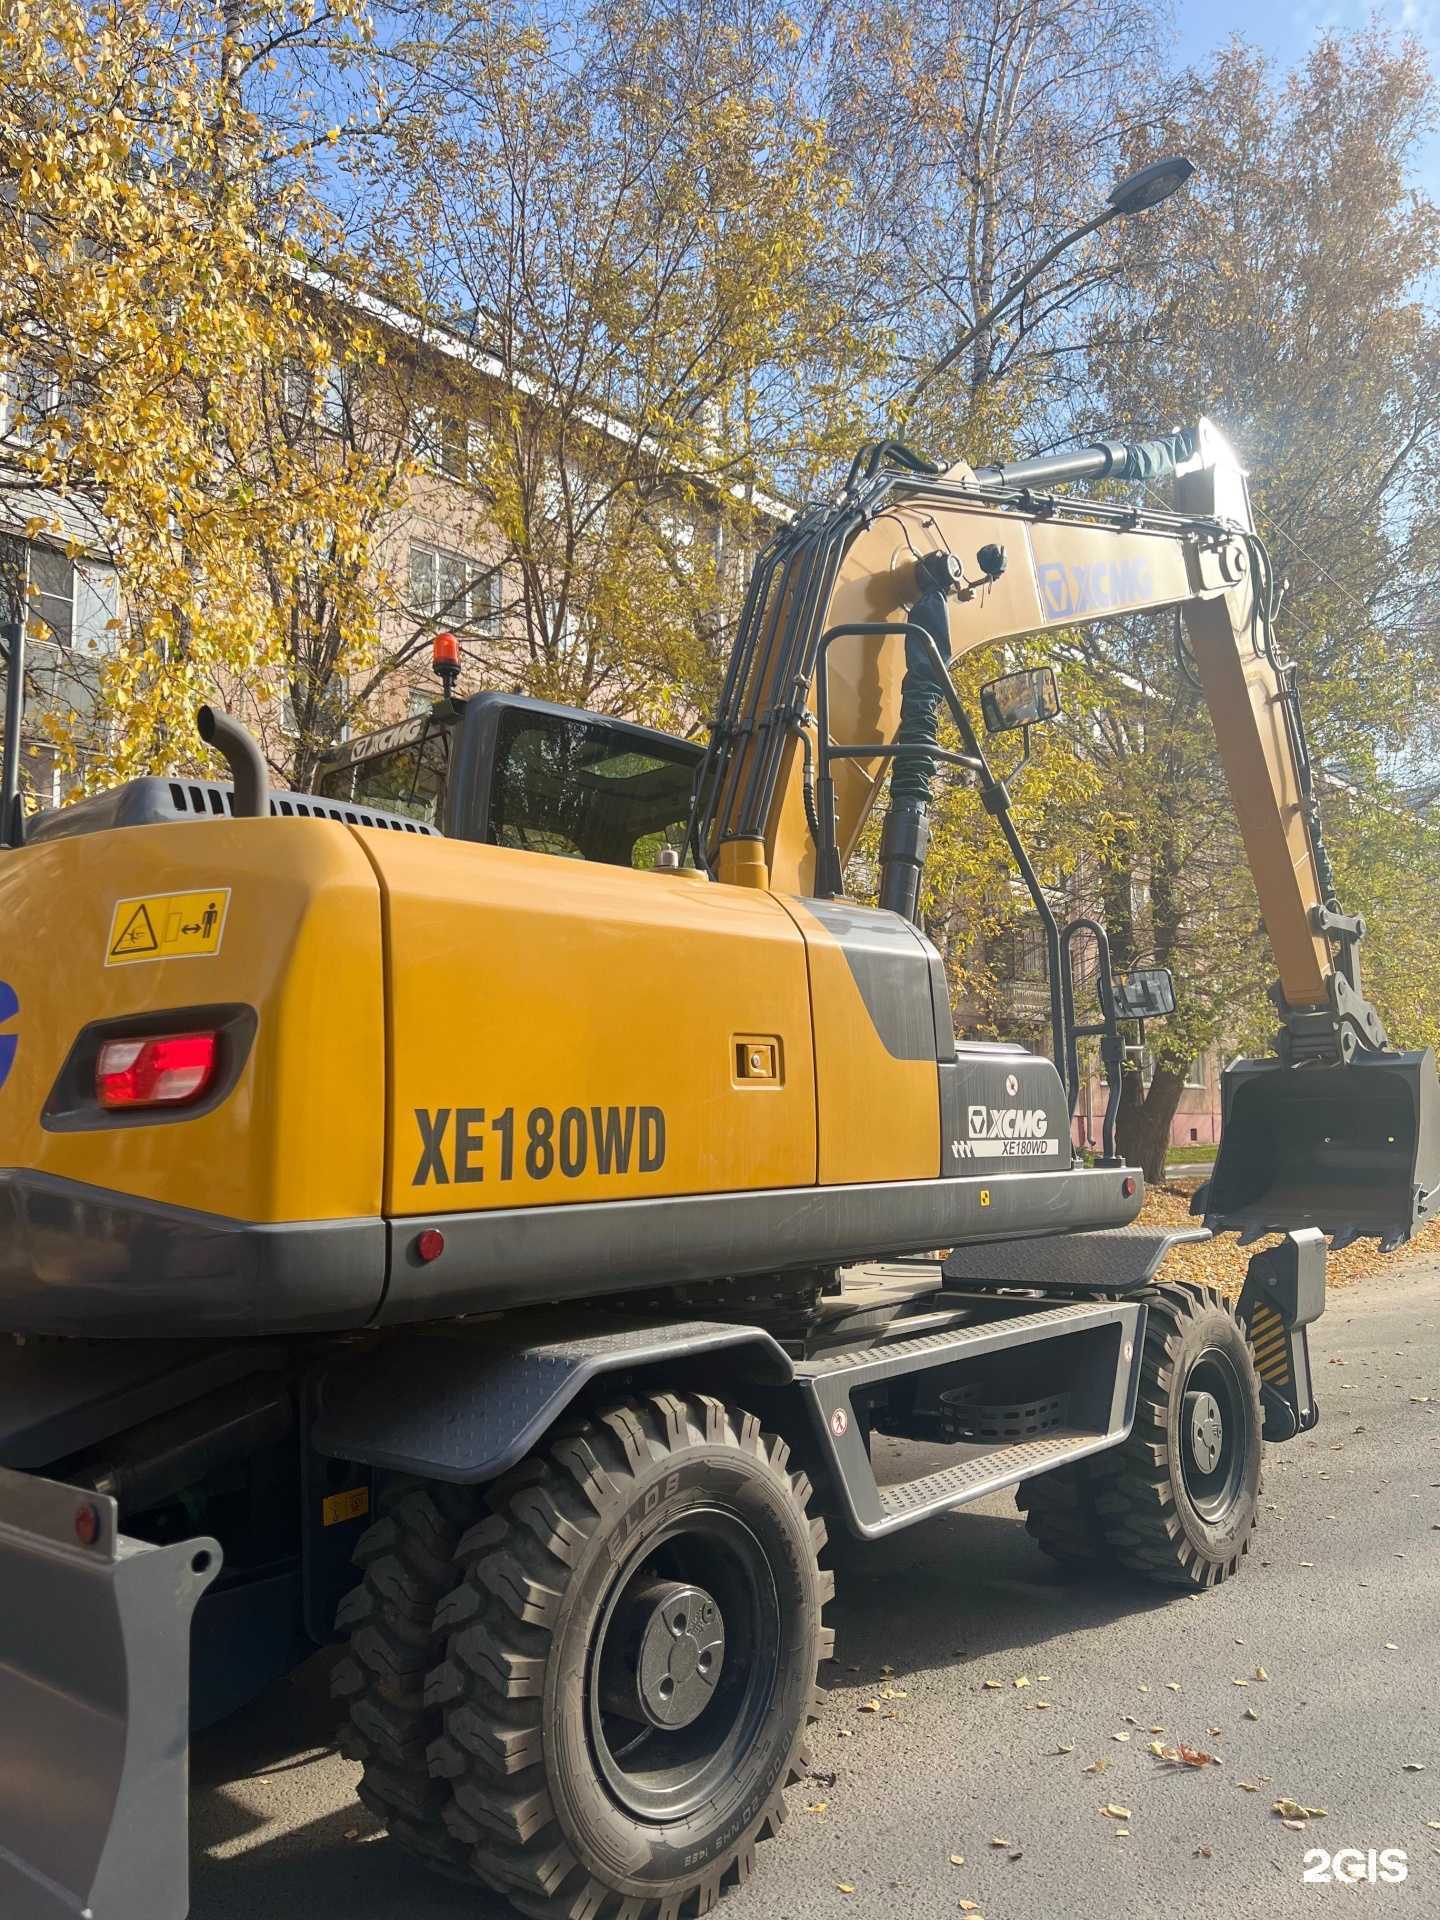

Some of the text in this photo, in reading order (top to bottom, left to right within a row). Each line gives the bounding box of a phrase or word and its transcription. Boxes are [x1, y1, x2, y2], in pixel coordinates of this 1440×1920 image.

[1070, 557, 1153, 614] XCMG
[368, 719, 422, 756] XCMG
[987, 1108, 1048, 1138] XCMG
[411, 1106, 667, 1186] XE180WD
[1001, 1140, 1048, 1156] XE180WD
